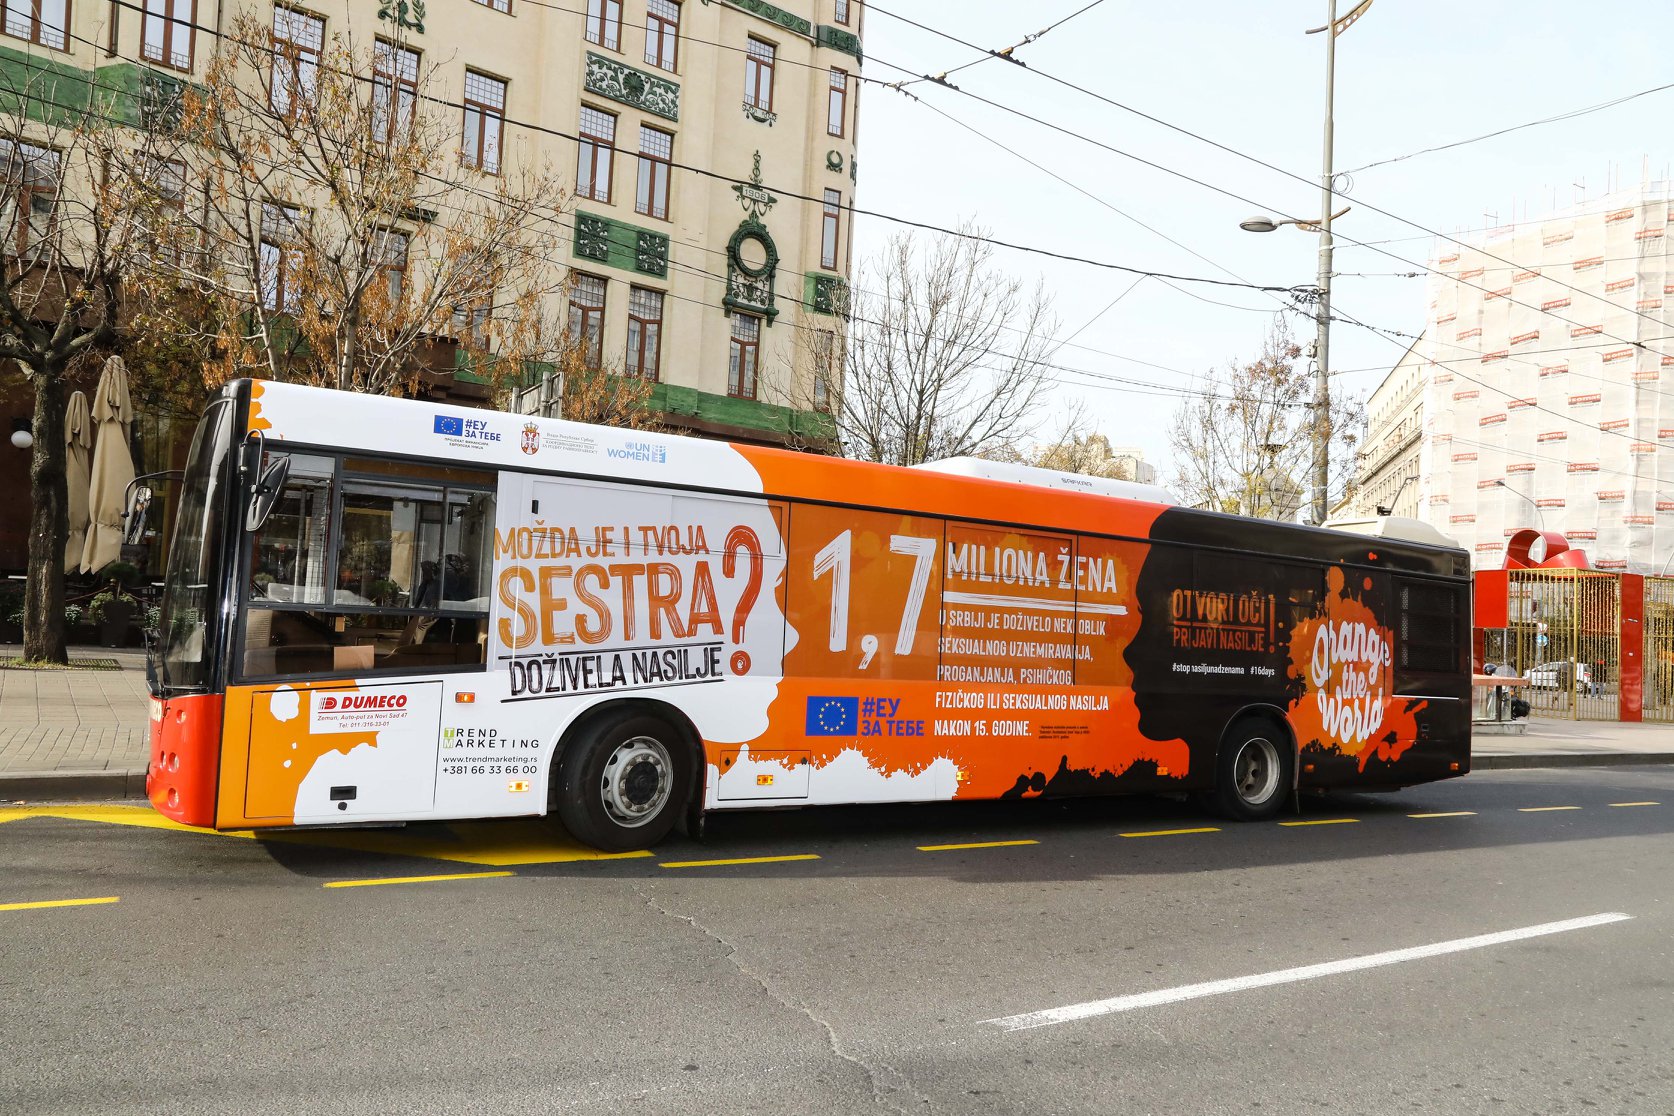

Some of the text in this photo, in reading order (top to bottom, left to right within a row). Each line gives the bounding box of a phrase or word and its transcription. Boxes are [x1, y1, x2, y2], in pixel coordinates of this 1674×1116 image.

[745, 189, 767, 201] 1906
[1568, 394, 1601, 403] isomat
[465, 430, 501, 441] ЗА ТЕБЕ
[607, 448, 650, 461] WOMEN
[635, 443, 650, 452] UN
[494, 520, 710, 560] MOŽDA JE I TVOJA
[813, 529, 1117, 670] 1,7 MILIONA ŽENA
[1172, 588, 1234, 622] OTVORI
[949, 611, 984, 628] SRBIJI
[987, 613, 1000, 629] JE
[1003, 612, 1051, 632] DOŽIVELO
[1078, 619, 1106, 636] OBLIK
[1173, 627, 1265, 652] PRIJAVI NASILJE
[938, 637, 1094, 662] SEKSUALNOG UZNEMIRAVANJA,
[1312, 620, 1391, 687] Orange
[509, 647, 723, 696] DOŽIVELA NASILJE
[937, 665, 1074, 686] PROGANJANJA, PSIHIČKOG,
[1250, 666, 1275, 677] #16days
[1341, 664, 1367, 699] the
[341, 695, 407, 709] DUMECO
[935, 689, 1109, 711] FIZIČKOG ILI SEKSUALNOG NASILJA
[1318, 687, 1385, 743] World
[444, 728, 497, 738] TREND
[861, 720, 924, 737] ЗА ТЕБЕ
[934, 719, 971, 737] NAKON
[974, 720, 989, 736] 15.
[992, 720, 1032, 737] GODINE.
[443, 739, 539, 748] MARKETING
[443, 766, 537, 774] +381 66 33 66 00
